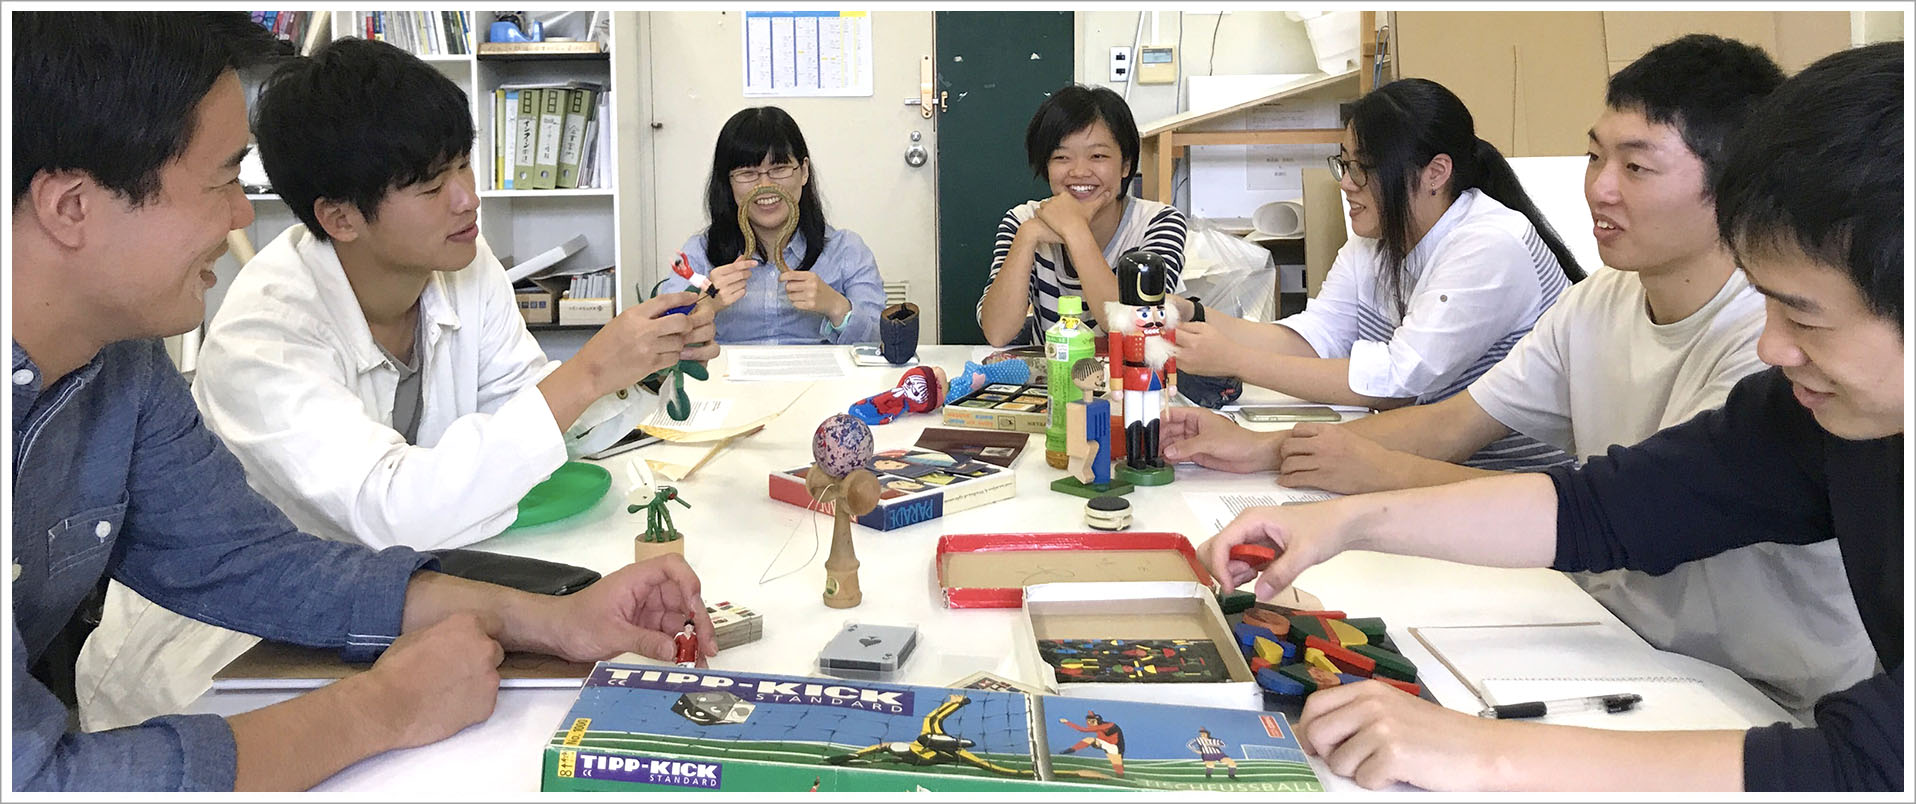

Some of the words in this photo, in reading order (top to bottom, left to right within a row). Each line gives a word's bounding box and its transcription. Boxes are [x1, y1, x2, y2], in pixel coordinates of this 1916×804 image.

[889, 499, 935, 528] PARADE
[605, 668, 903, 706] TIPP-KICK
[755, 693, 903, 713] STANDARD
[580, 754, 718, 778] TIPP-KICK
[650, 774, 717, 787] STANDARD
